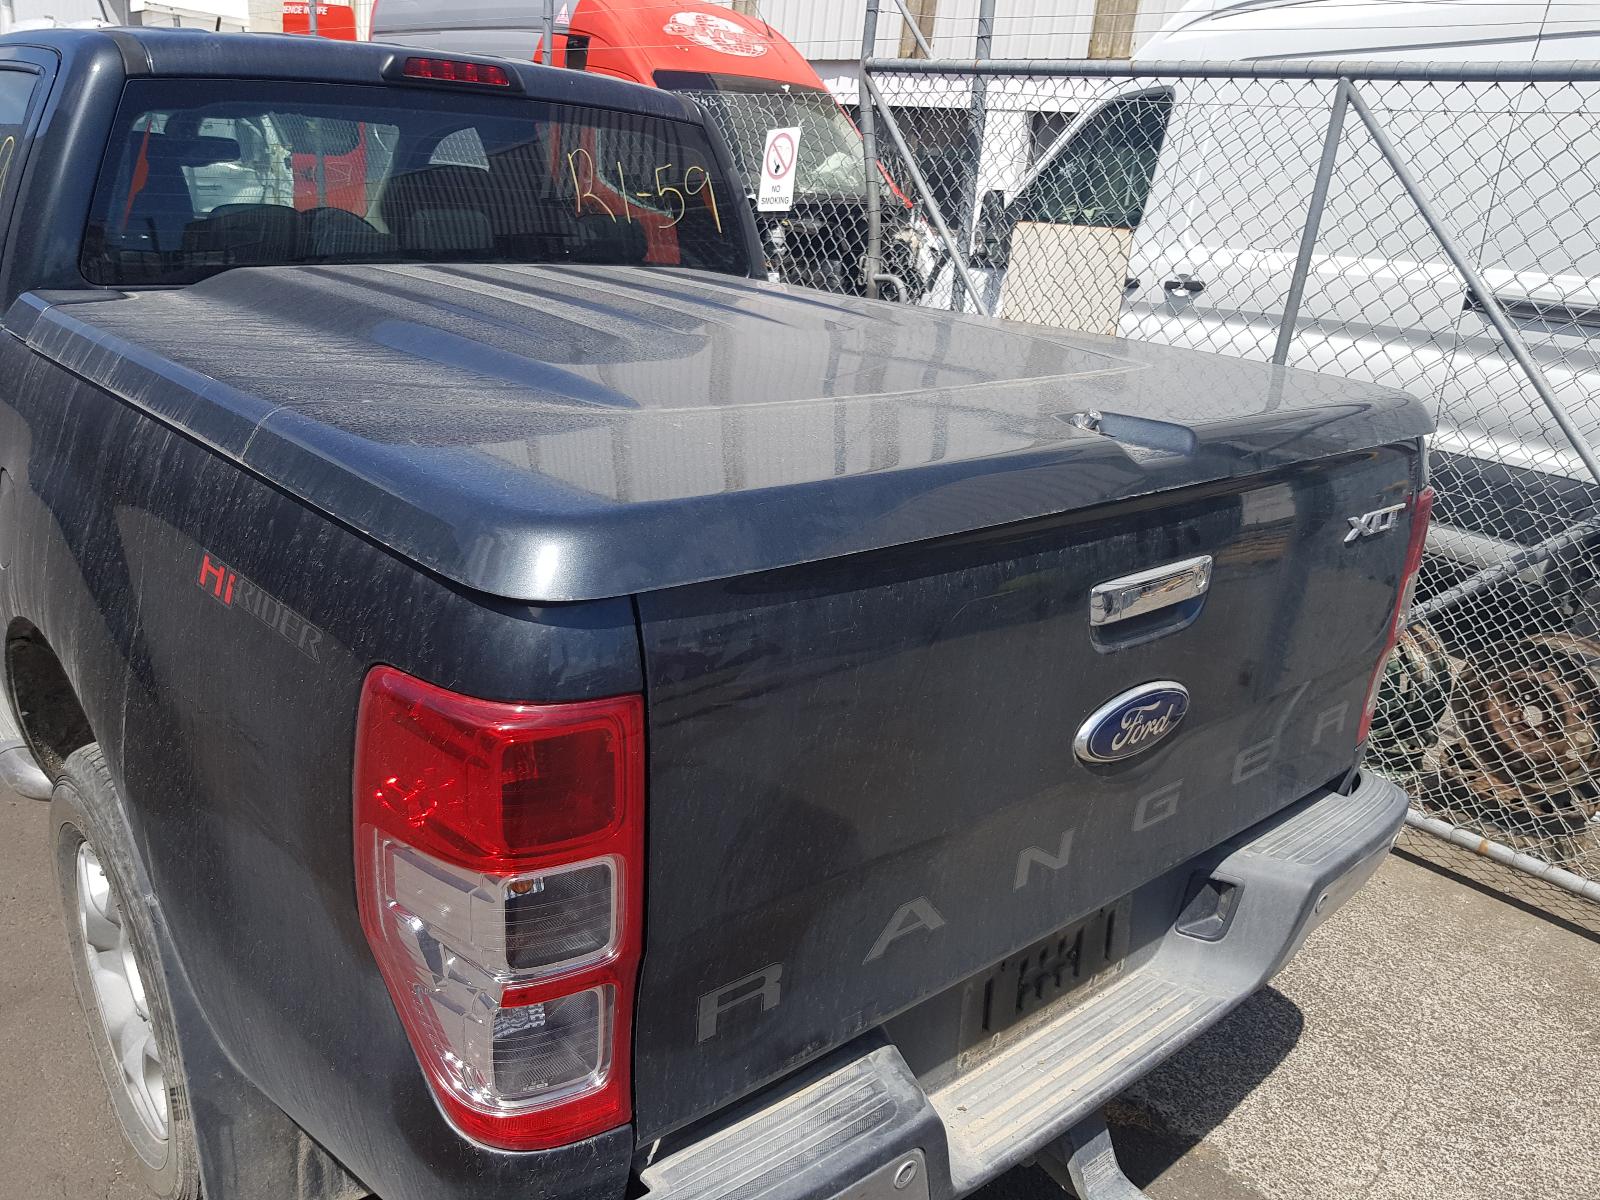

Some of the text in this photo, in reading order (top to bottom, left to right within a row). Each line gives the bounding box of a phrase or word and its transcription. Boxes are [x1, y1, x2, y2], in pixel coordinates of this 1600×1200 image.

[761, 196, 790, 205] SMOKING
[771, 185, 781, 193] NO
[1343, 502, 1408, 543] XLT
[1111, 700, 1174, 751] Ford
[695, 700, 1350, 1044] RANGER
